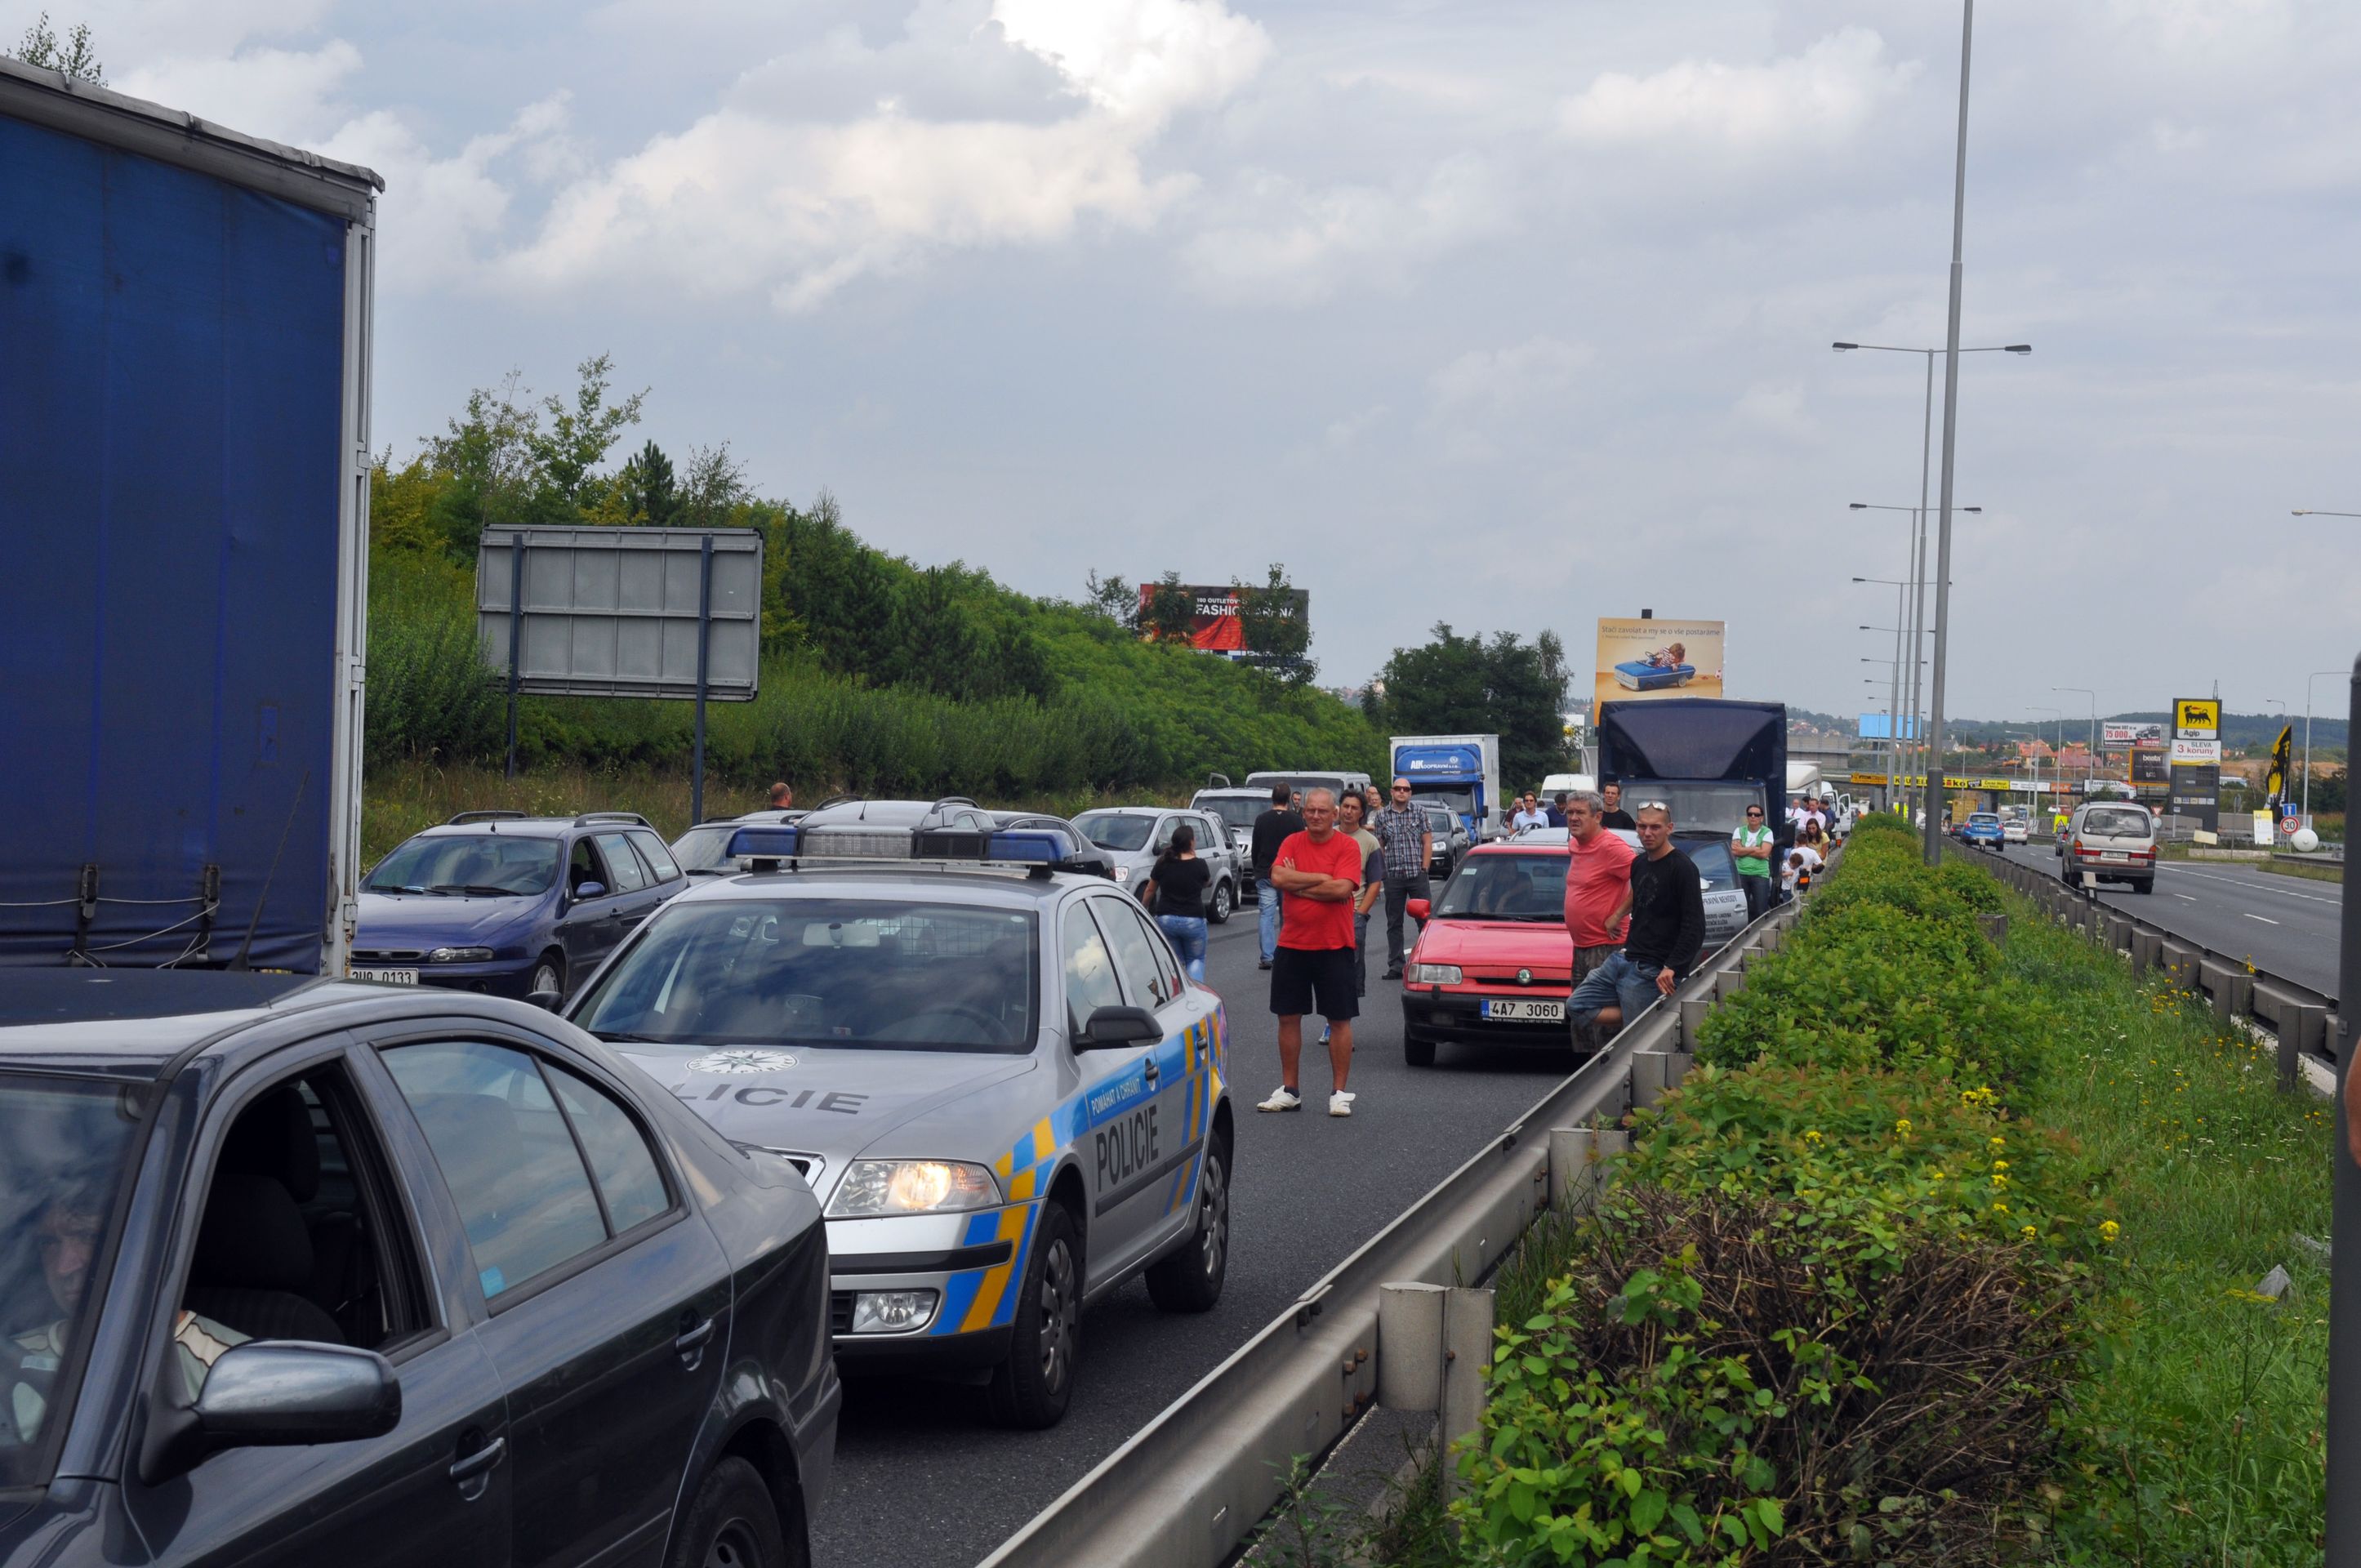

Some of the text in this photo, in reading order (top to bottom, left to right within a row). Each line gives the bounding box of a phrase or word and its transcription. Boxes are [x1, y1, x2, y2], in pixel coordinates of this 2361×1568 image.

[1674, 627, 1685, 635] vše
[1686, 627, 1720, 637] postaráme
[2105, 730, 2114, 738] 75
[2114, 730, 2128, 738] 000
[2184, 729, 2200, 737] Agip
[2177, 744, 2214, 755] 3 koruny
[2284, 821, 2296, 830] 30
[1492, 1002, 1559, 1018] 4A7 3060
[670, 1083, 870, 1115] LICIE
[1091, 1078, 1141, 1116] POMÁHAT A CHRÁNIT
[1096, 1104, 1159, 1192] POLICIE
